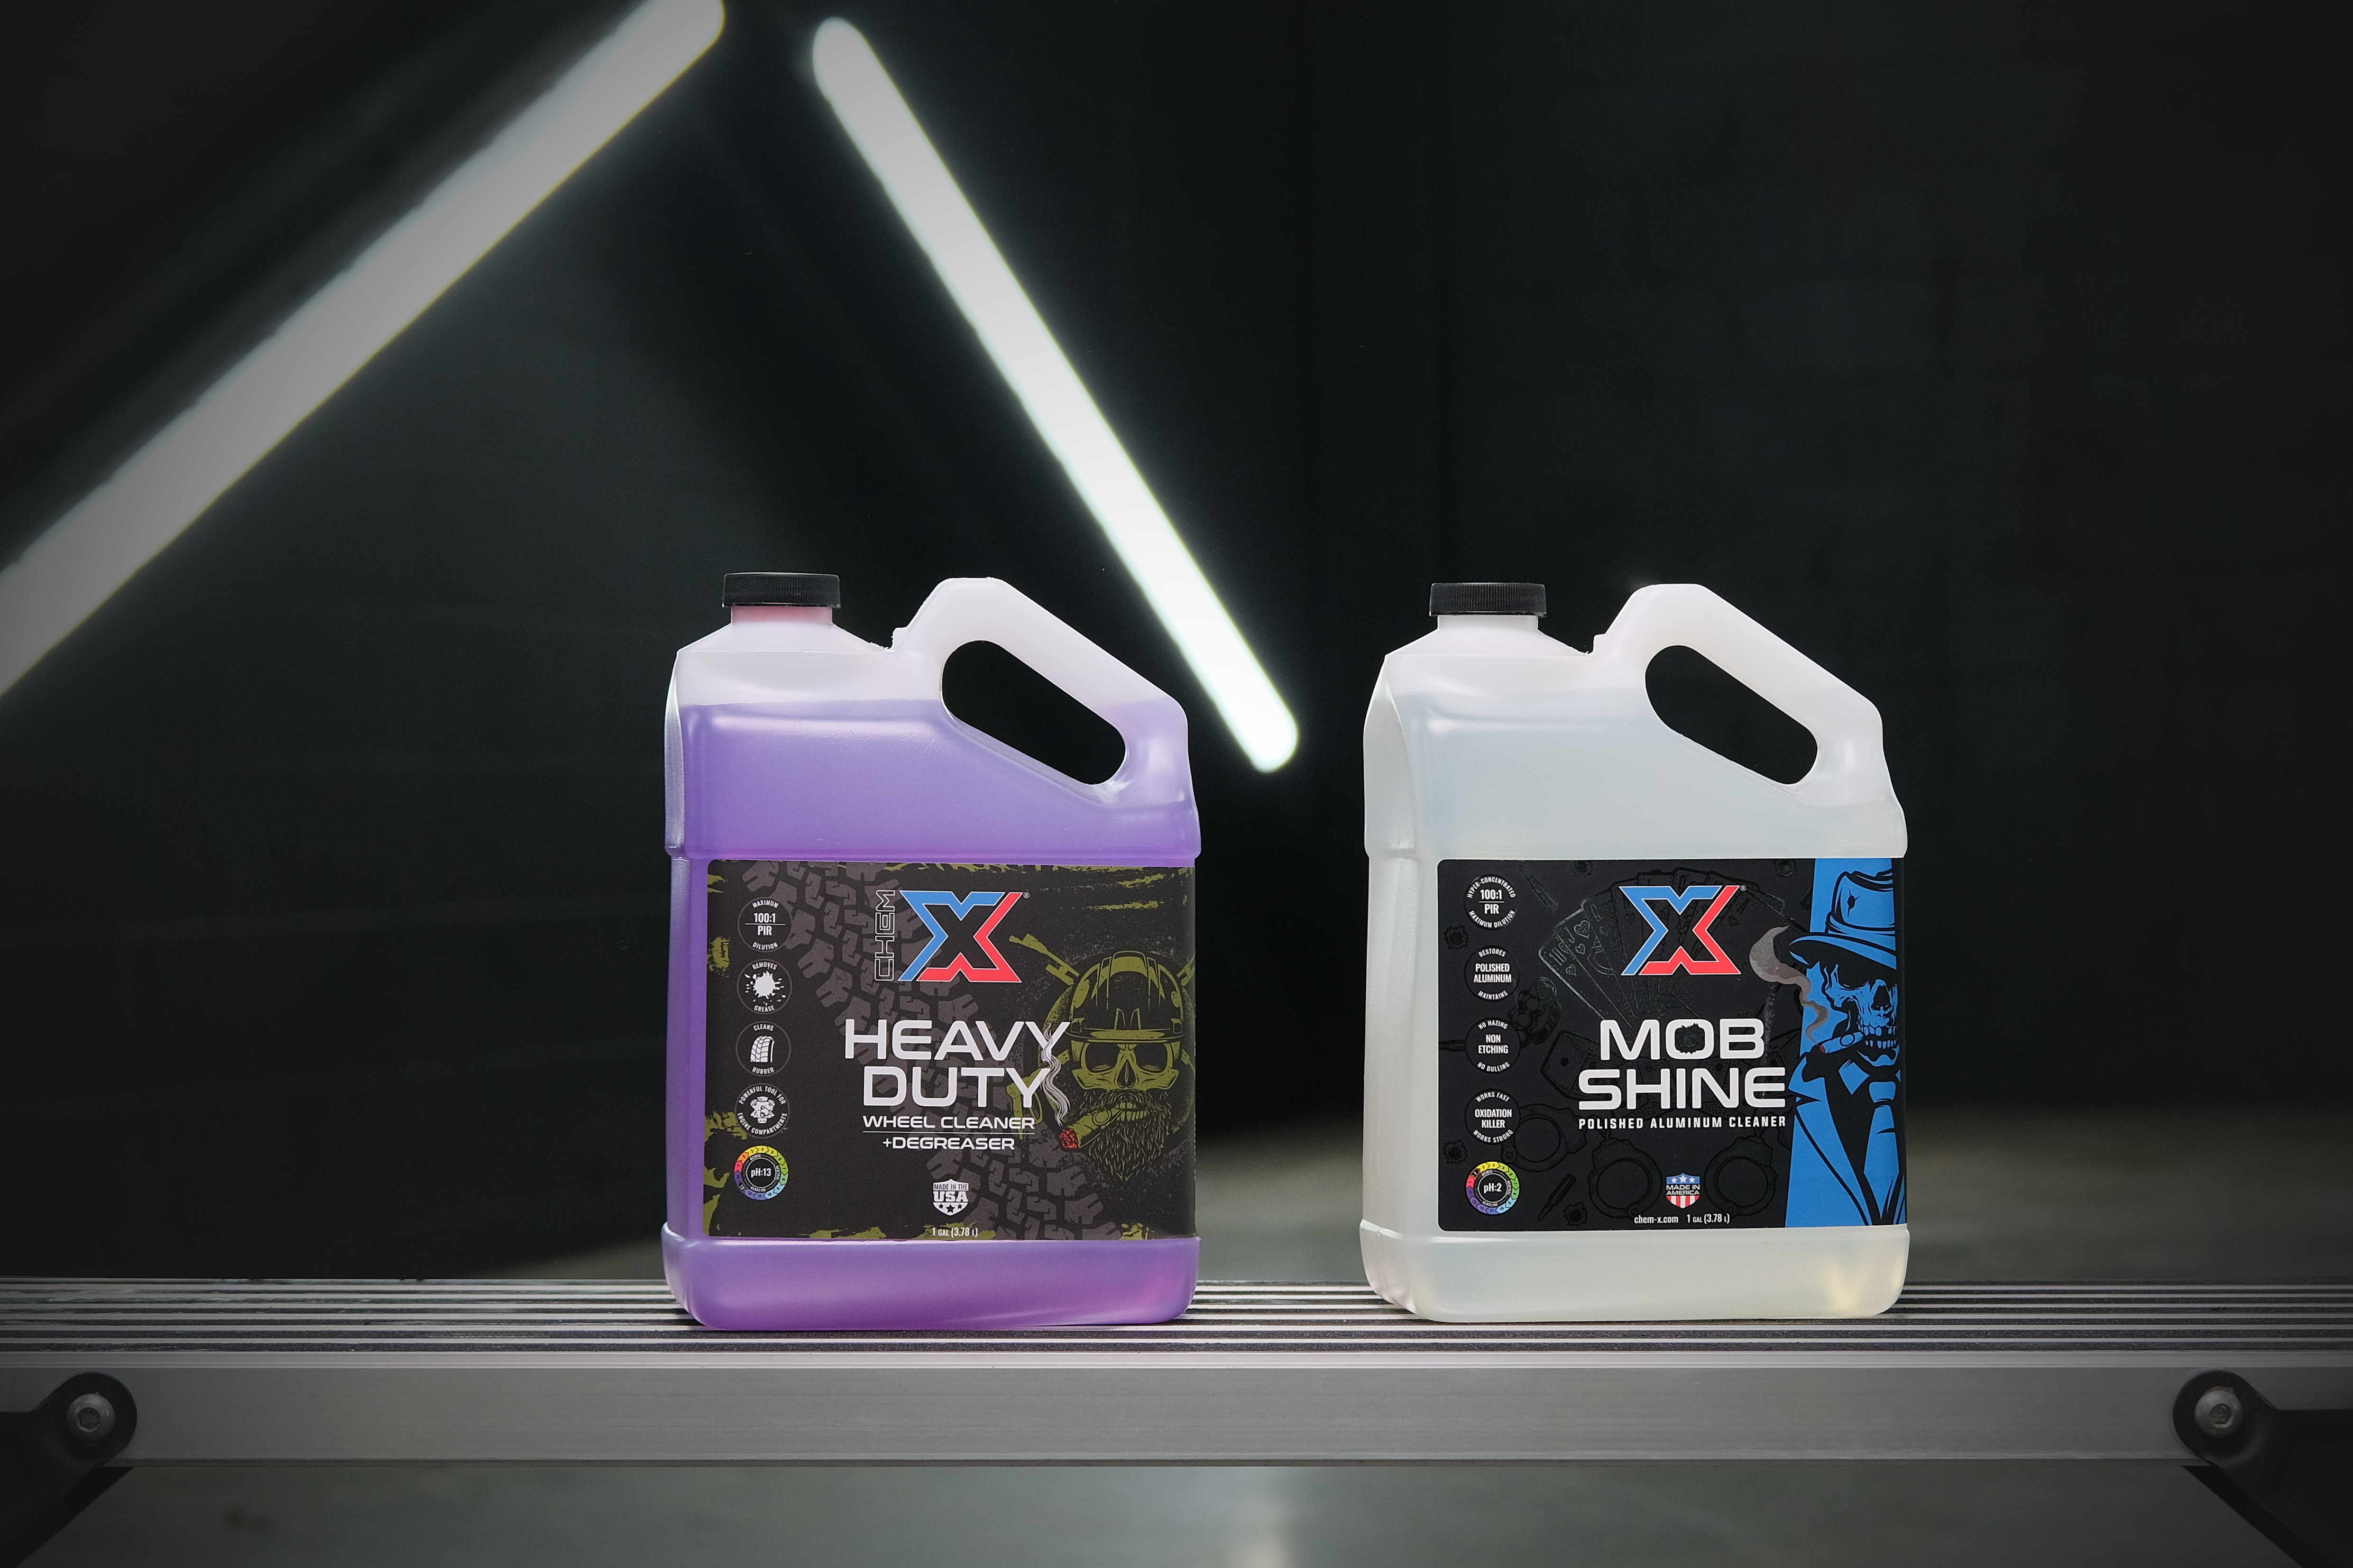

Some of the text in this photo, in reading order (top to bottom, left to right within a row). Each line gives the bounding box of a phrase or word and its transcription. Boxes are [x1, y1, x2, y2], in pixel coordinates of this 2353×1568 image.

[1467, 876, 1516, 899] HYPER-CONCENTRATED
[1480, 889, 1502, 899] 100:1
[752, 899, 779, 908] MAXIMUM
[1484, 904, 1499, 914] PIR
[754, 913, 776, 923] 100:1
[1469, 909, 1515, 928] MAXIMUM DILUTION
[757, 926, 772, 935] PIR
[874, 889, 895, 981] CHEM
[752, 942, 778, 951] DILUTION
[1478, 948, 1506, 957] RESTORES
[752, 962, 777, 970] REMOVES
[1475, 963, 1510, 972] POLISHED
[1473, 973, 1512, 983] ALUMINUM
[1478, 990, 1508, 1000] MAINTAINS
[1478, 1020, 1508, 1030] NO HAZING
[845, 1019, 1070, 1061] HEAVY
[1486, 1034, 1501, 1043] NON
[1600, 1018, 1765, 1060] MOB
[1478, 1045, 1509, 1054] ETCHING
[752, 1066, 774, 1074] RUBBER
[1477, 1062, 1510, 1072] NO DULLING
[863, 1066, 1050, 1108] DUTY
[1579, 1067, 1785, 1110] SHINE
[738, 1086, 786, 1105] POWERFUL TOOL FOR
[1475, 1091, 1510, 1102] WORKS FAST
[1474, 1109, 1512, 1118] OXIDATION
[737, 1112, 787, 1135] ENGINE COMPARTMENTS
[863, 1115, 1035, 1129] WHEEL CLEANER
[1481, 1119, 1506, 1128] KILLER
[1579, 1116, 1786, 1130] POLISHED ALUMINUM CLEANER
[1473, 1129, 1514, 1143] WORKS STRONG
[882, 1137, 1015, 1150] +DEGREASER
[751, 1168, 772, 1178] pH:13
[1483, 1183, 1502, 1194] pH:2
[933, 1191, 968, 1202] USA
[1634, 1215, 1679, 1224] chem-x.com
[1686, 1214, 1691, 1223] 1
[1704, 1213, 1722, 1224] (3.78
[1724, 1213, 1730, 1224] L)
[932, 1227, 936, 1236] 1
[951, 1227, 970, 1238] (3.78
[972, 1227, 978, 1238] L)
